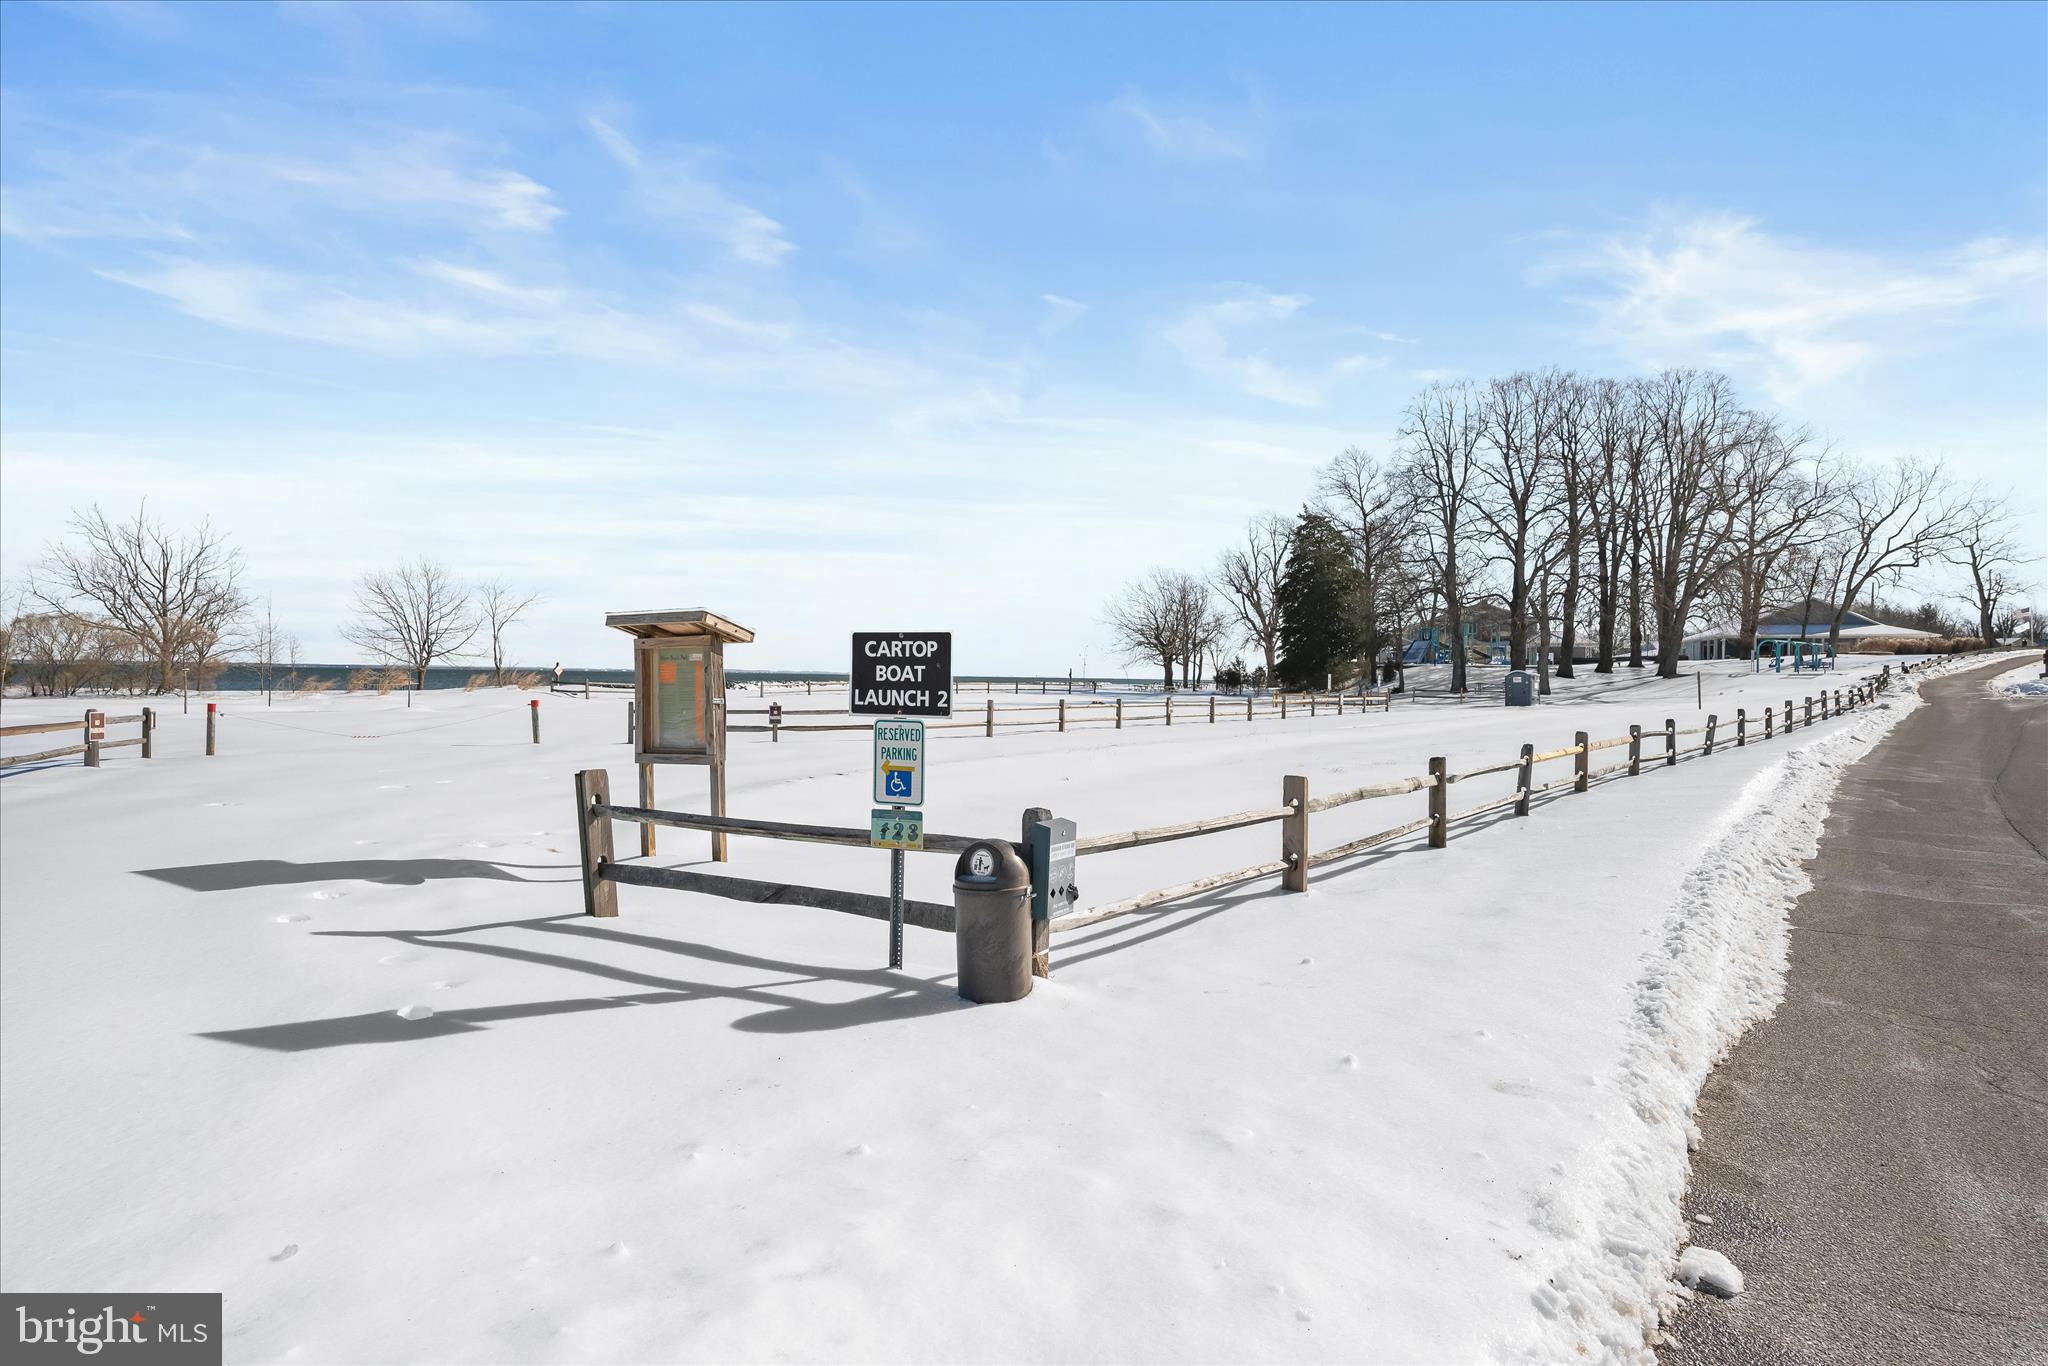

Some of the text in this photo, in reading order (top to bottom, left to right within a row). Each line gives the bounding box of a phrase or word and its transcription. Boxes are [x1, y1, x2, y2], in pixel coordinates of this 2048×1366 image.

[864, 640, 938, 657] CARTOP
[875, 665, 926, 682] BOAT
[854, 689, 948, 708] LAUNCH 2
[877, 727, 921, 742] RESERVED
[881, 746, 917, 761] PARKING
